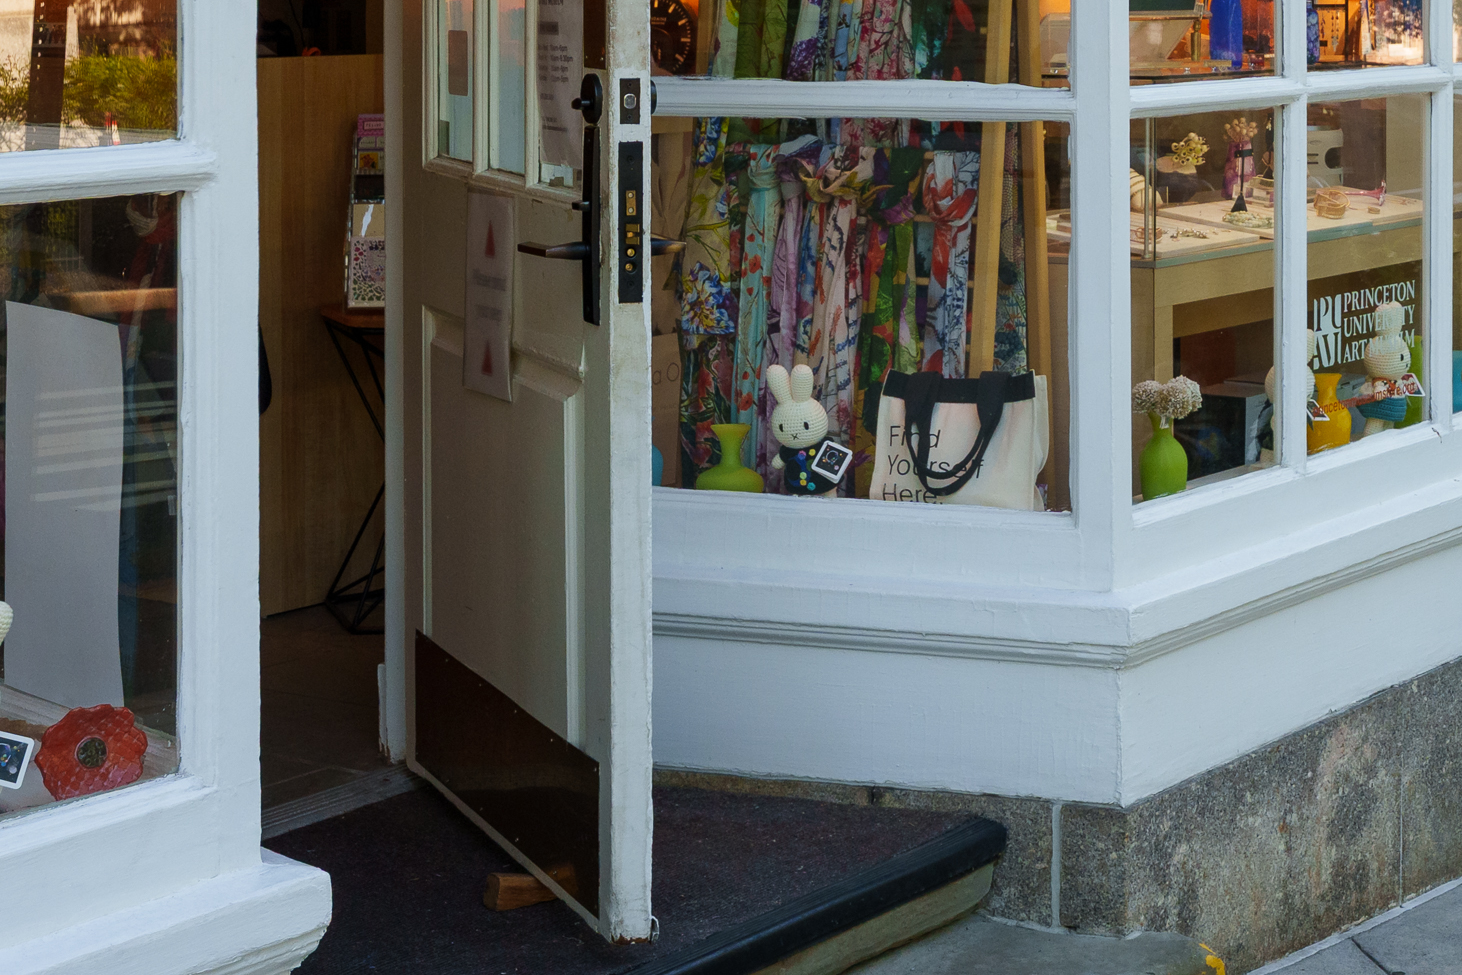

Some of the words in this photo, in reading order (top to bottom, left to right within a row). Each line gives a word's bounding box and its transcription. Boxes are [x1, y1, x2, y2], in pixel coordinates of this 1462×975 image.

[1343, 279, 1416, 313] PRINCETON
[1343, 303, 1416, 338] UNIVERTY
[1343, 338, 1369, 364] ART
[887, 454, 984, 479] Yorsef
